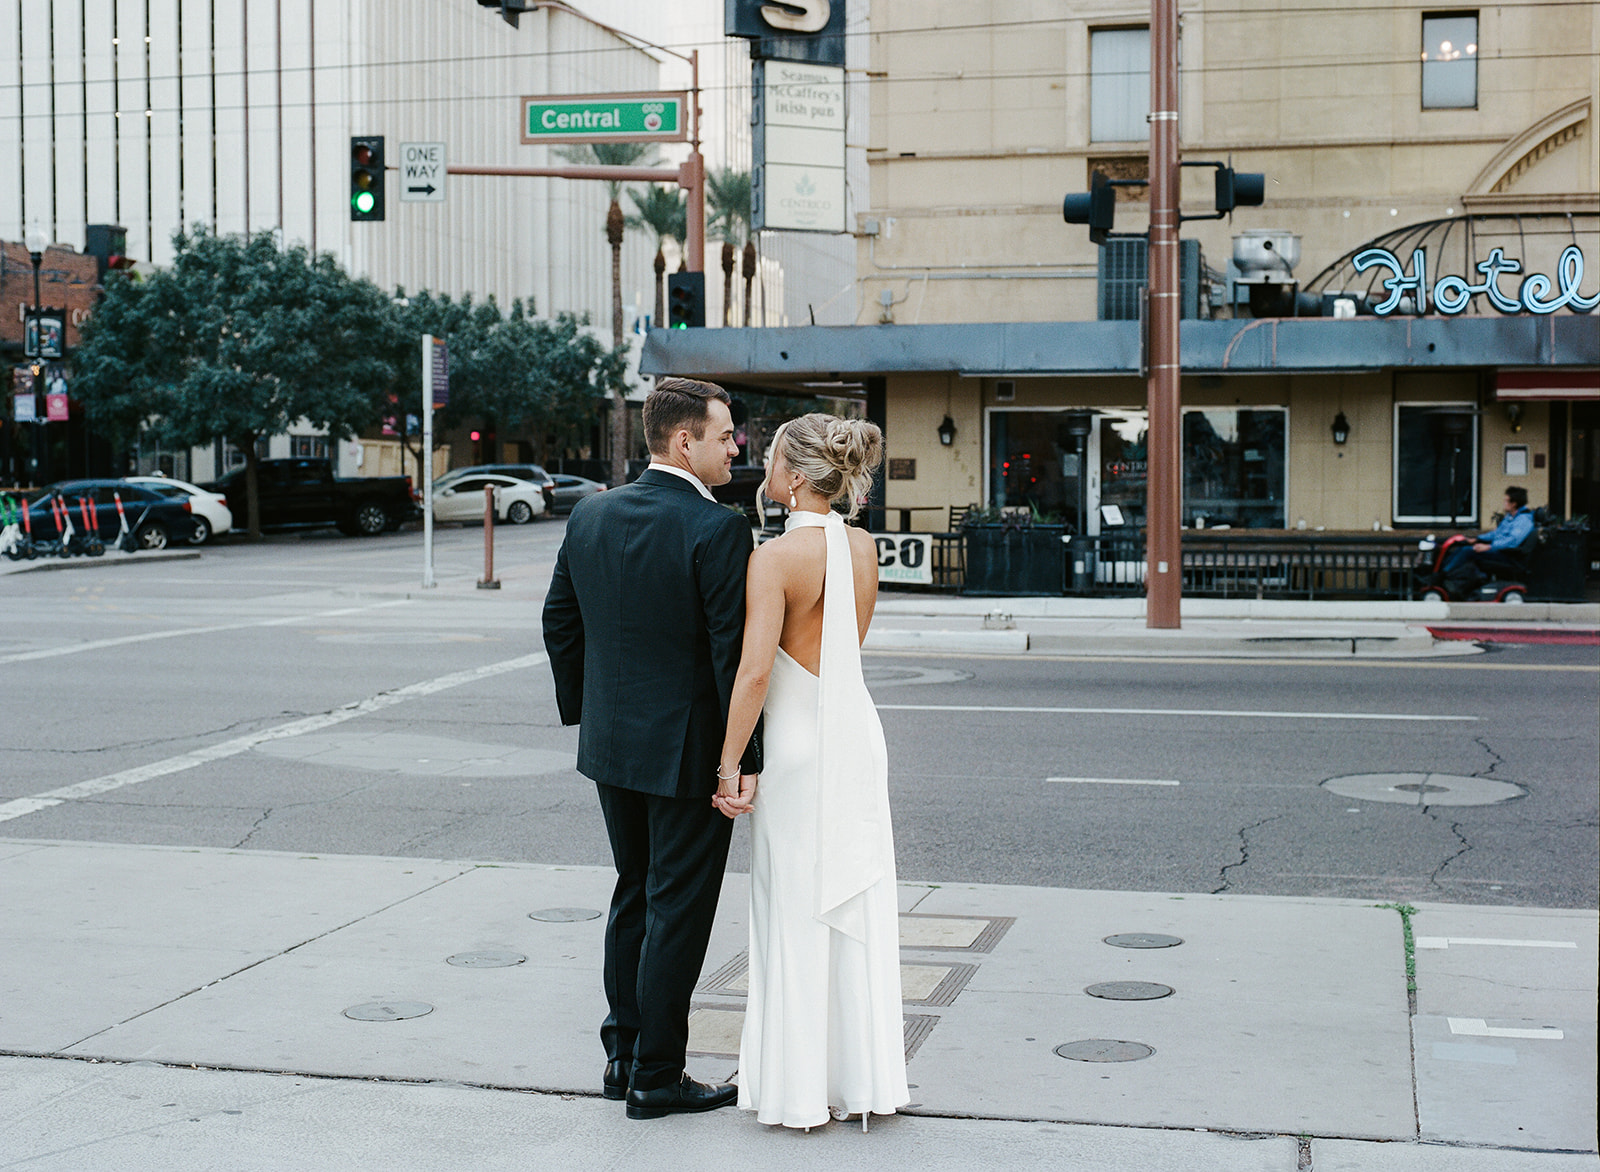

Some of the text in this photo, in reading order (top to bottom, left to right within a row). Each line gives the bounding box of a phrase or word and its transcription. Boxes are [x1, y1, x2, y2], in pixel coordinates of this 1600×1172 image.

[781, 69, 829, 83] Seamus
[767, 84, 841, 103] McCaffrey's
[541, 108, 621, 129] Central
[406, 147, 438, 161] ONE
[405, 165, 439, 178] WAY
[1352, 245, 1600, 315] Hotel
[875, 537, 924, 568] CO
[884, 568, 923, 579] MEZCAL
